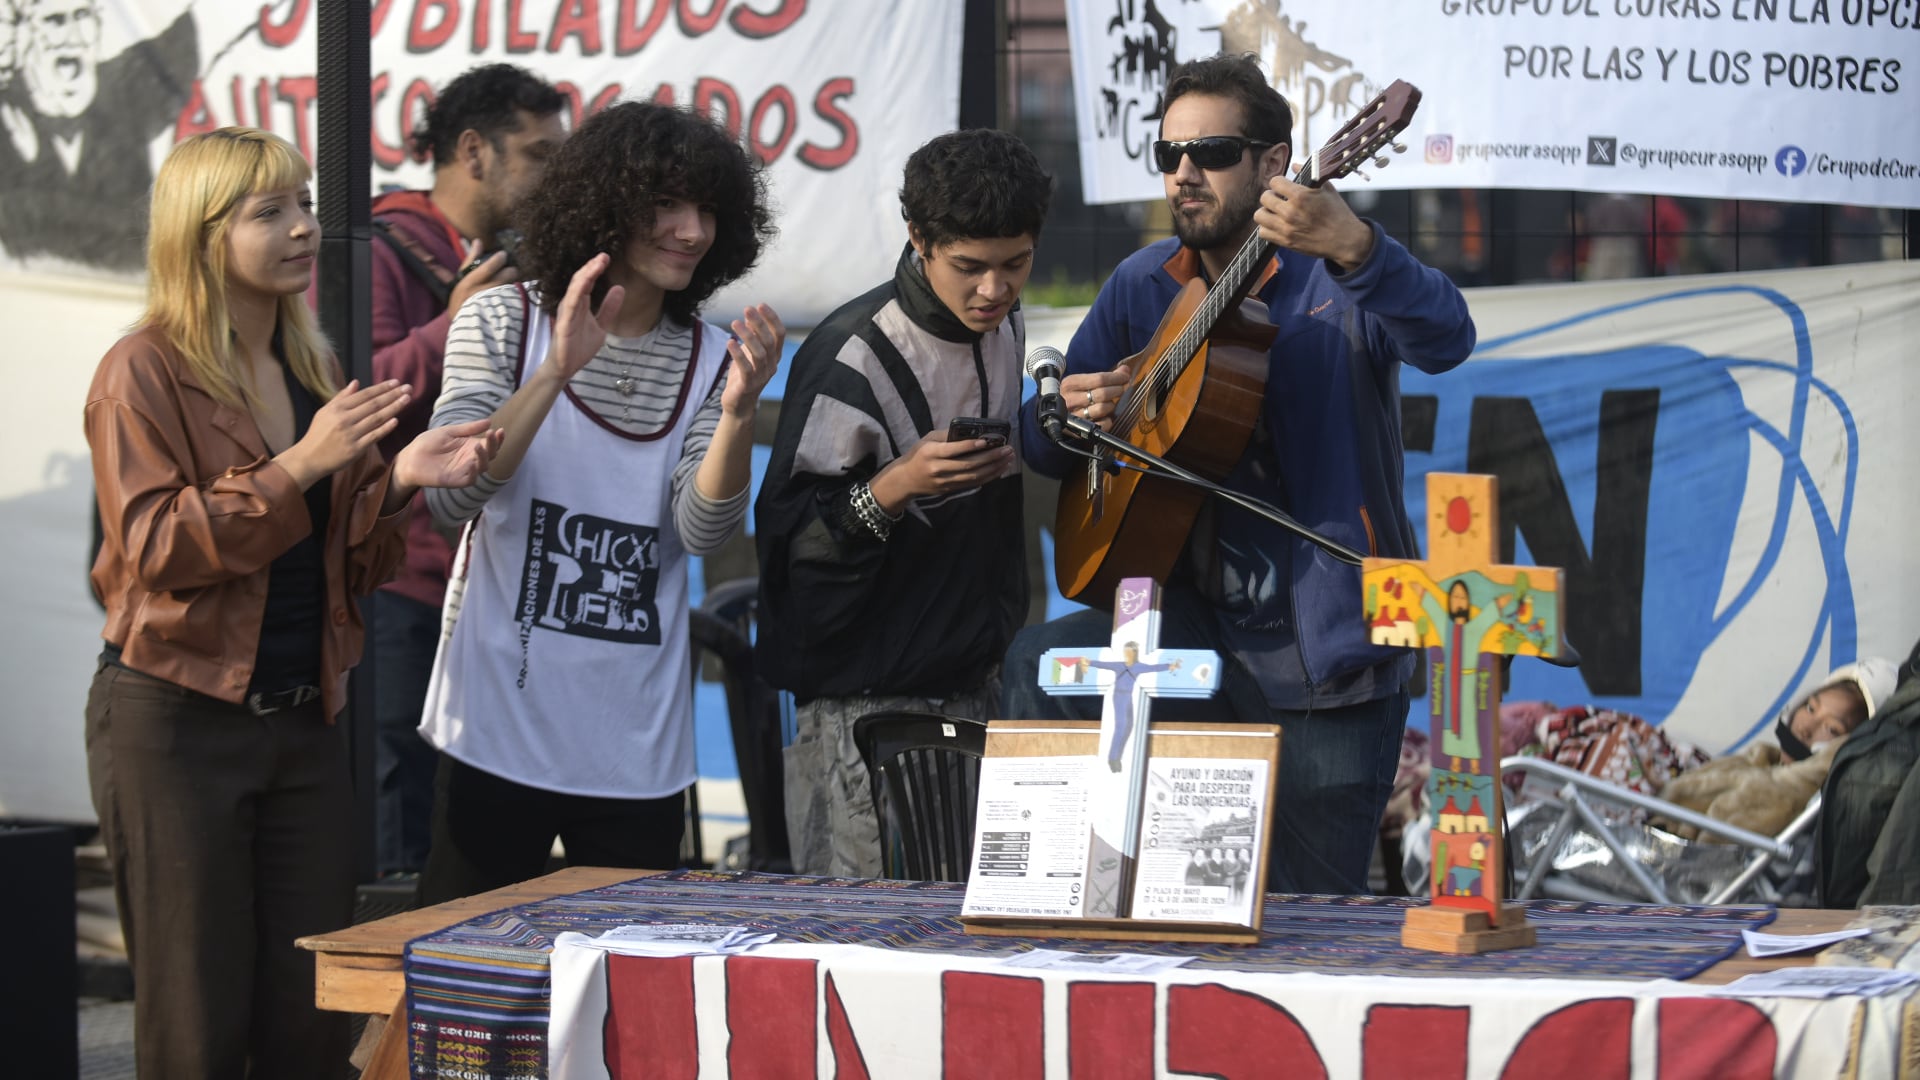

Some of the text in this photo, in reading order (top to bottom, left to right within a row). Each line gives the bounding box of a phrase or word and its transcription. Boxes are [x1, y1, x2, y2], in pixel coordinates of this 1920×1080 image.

[1503, 45, 1902, 94] POR LAS Y LOS POBRES
[1456, 141, 1582, 166] grupocurasopp
[1620, 143, 1768, 176] @grupocurasopp
[1806, 152, 1920, 181] /GrupodeCur
[534, 506, 547, 529] LXS
[532, 541, 544, 557] DE
[557, 508, 660, 571] CHICXS
[1170, 766, 1254, 781] AYUNO Y ORACIÓN
[1173, 782, 1251, 794] PARA DESPERTAR
[1172, 795, 1250, 808] LAS CONCIENCIAS
[1152, 887, 1201, 896] PLAZA DE MAYO
